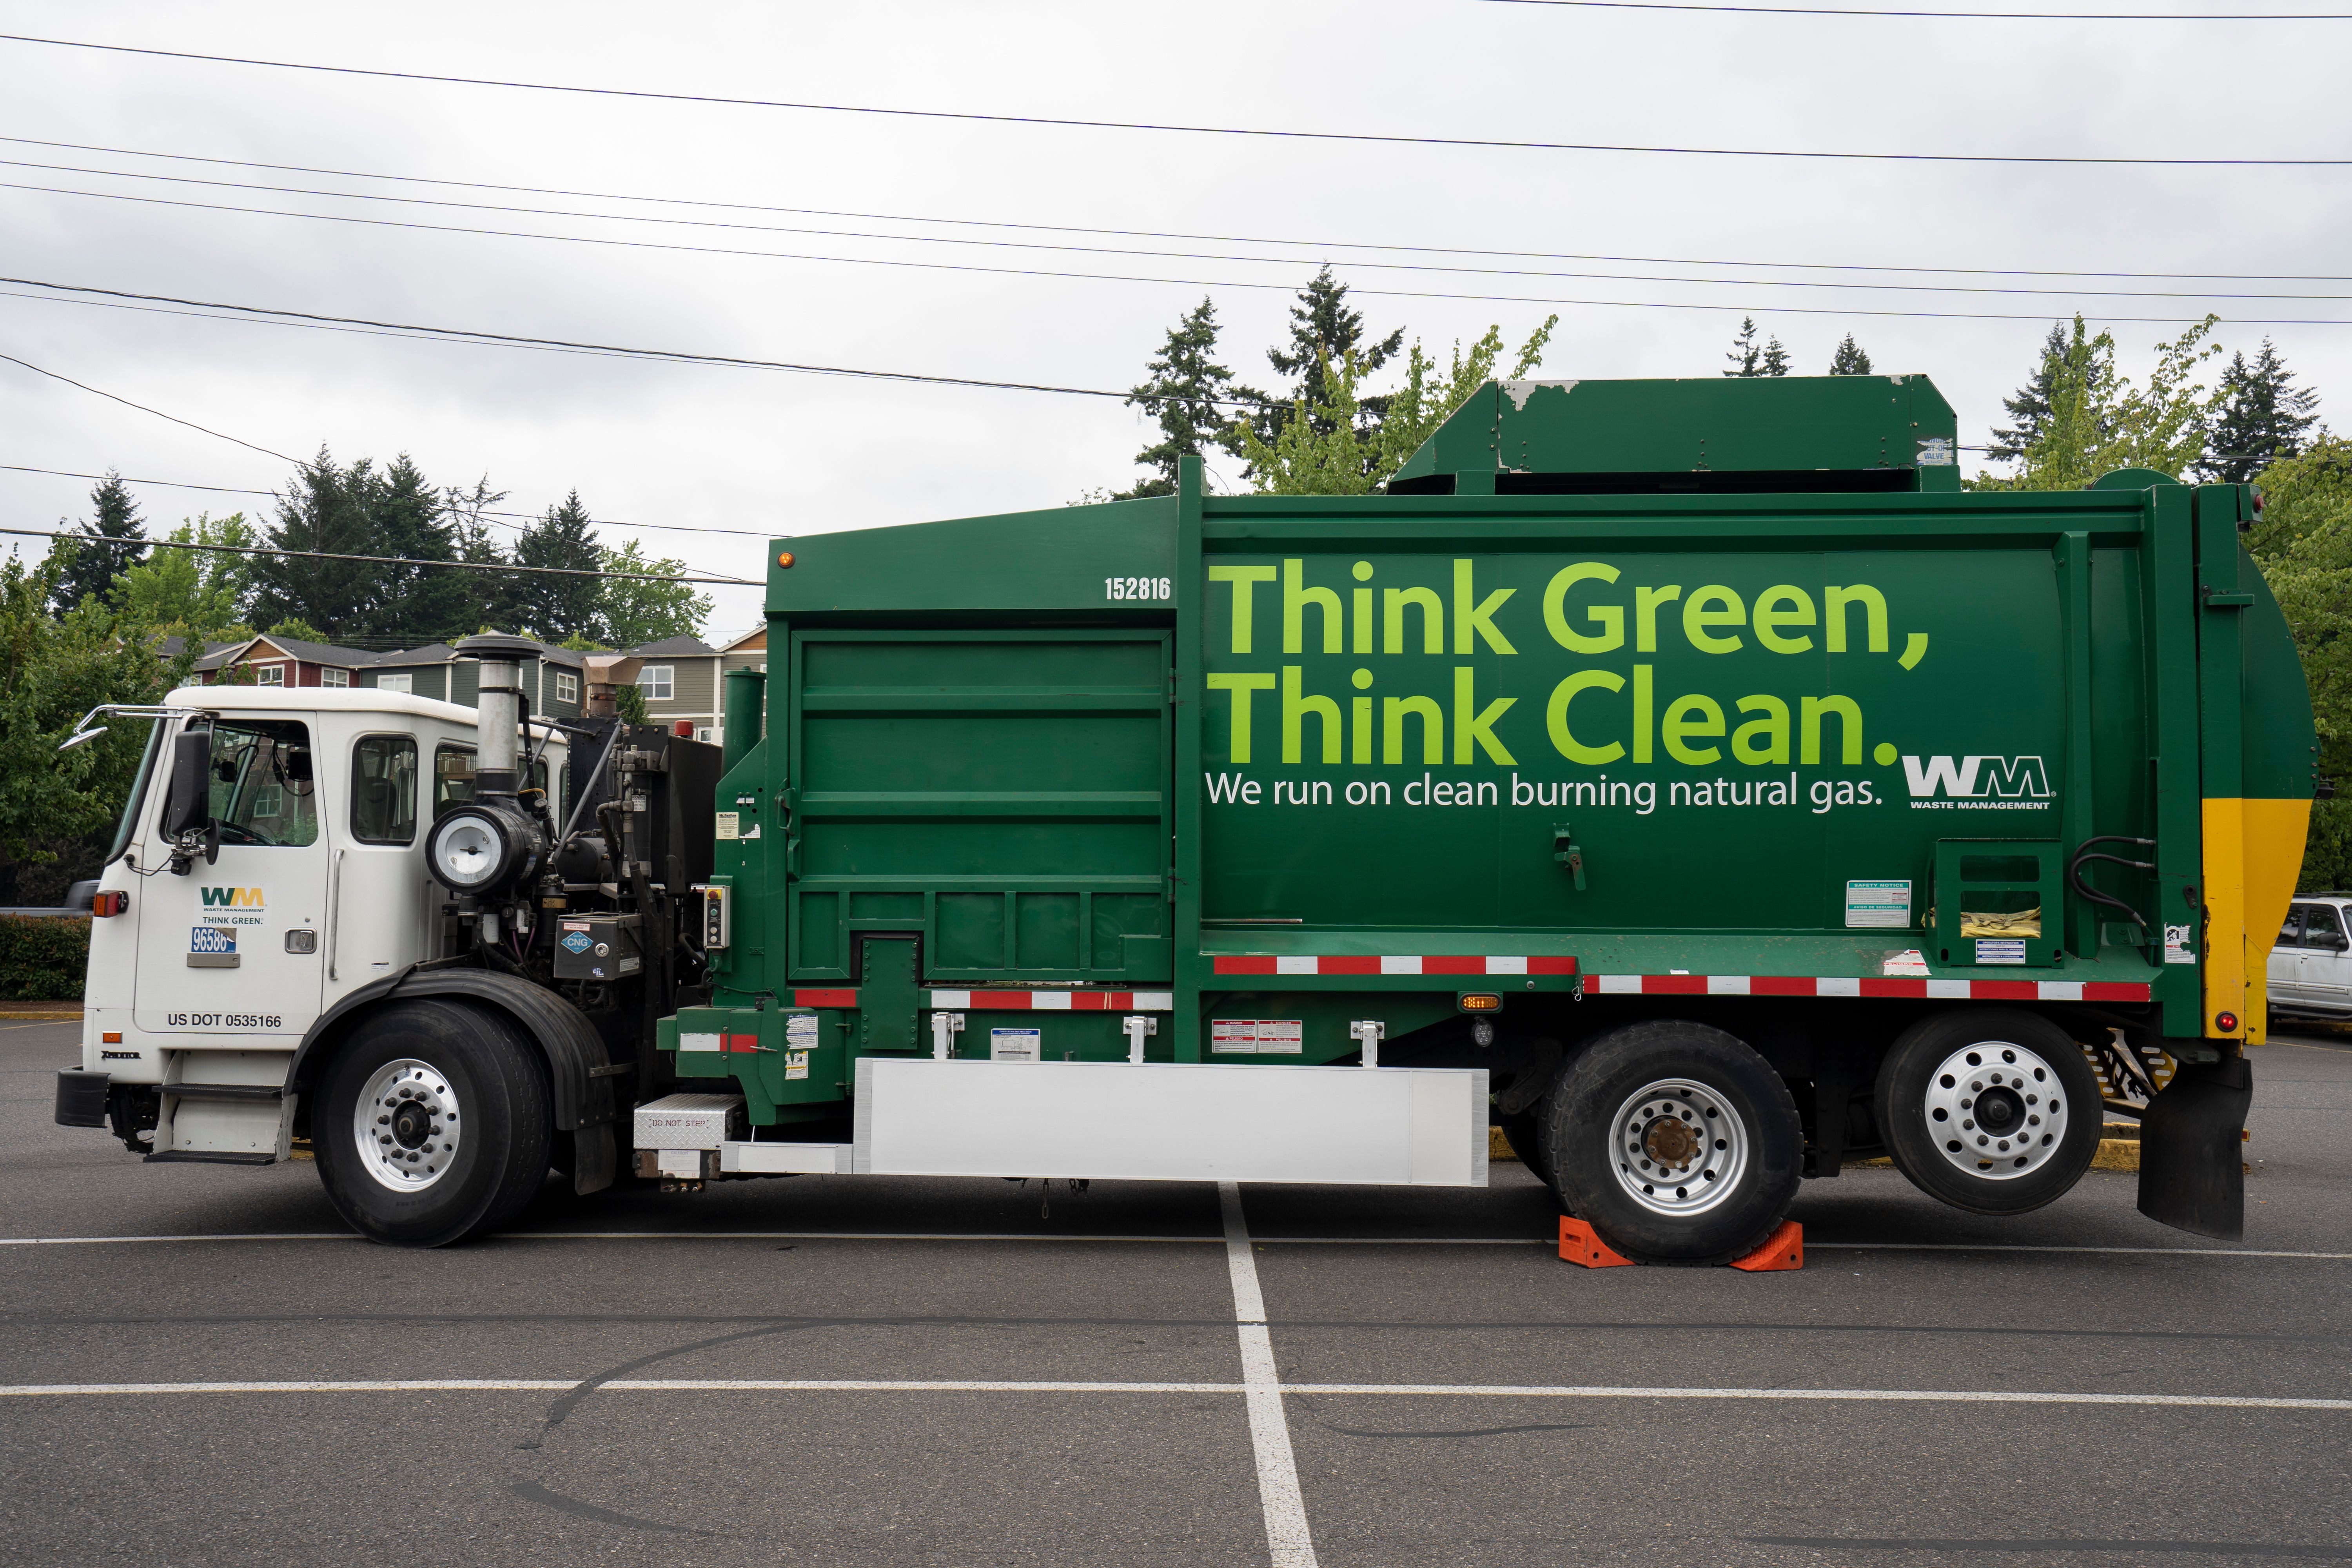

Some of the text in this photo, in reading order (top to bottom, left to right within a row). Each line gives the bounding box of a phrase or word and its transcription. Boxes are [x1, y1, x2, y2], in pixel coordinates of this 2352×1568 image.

[1105, 577, 1170, 600] 152816
[1209, 559, 1928, 670] Think Green,
[1207, 664, 1898, 765] Think Clean.
[1902, 755, 2050, 797] WM
[1205, 771, 1882, 815] We run on clean burning natural gas.
[201, 887, 265, 907] WM
[193, 928, 227, 951] 96586
[567, 938, 588, 946] CNG
[168, 1014, 281, 1027] US DOT 0535166
